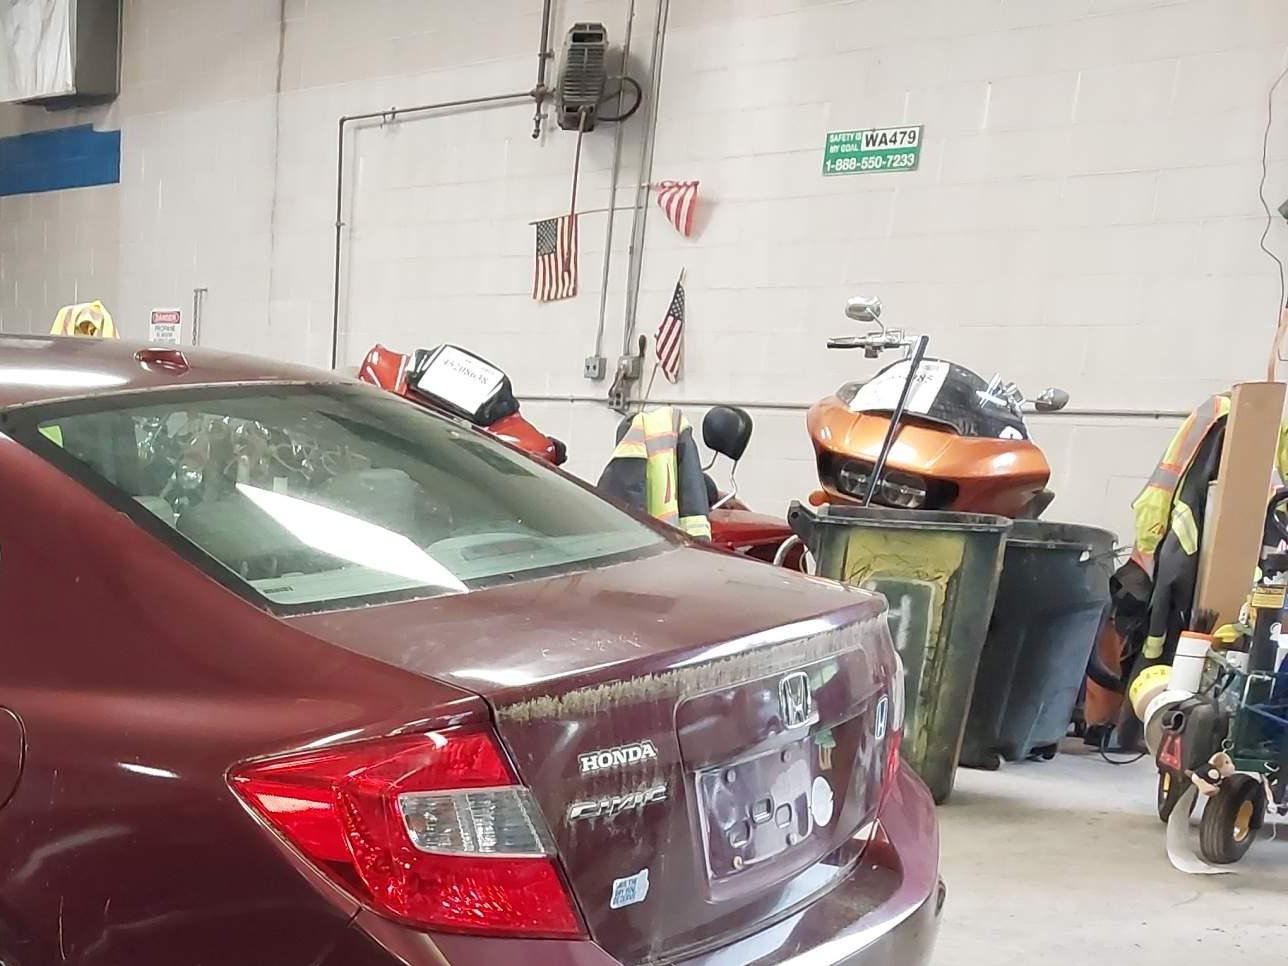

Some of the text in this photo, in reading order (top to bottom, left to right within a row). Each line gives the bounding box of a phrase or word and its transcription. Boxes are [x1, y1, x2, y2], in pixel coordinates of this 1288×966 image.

[829, 132, 856, 143] SAFETY
[864, 130, 916, 148] WA479
[825, 153, 915, 172] 1-888-550-7233
[579, 742, 657, 773] HONDA
[568, 784, 668, 820] CIVIC
